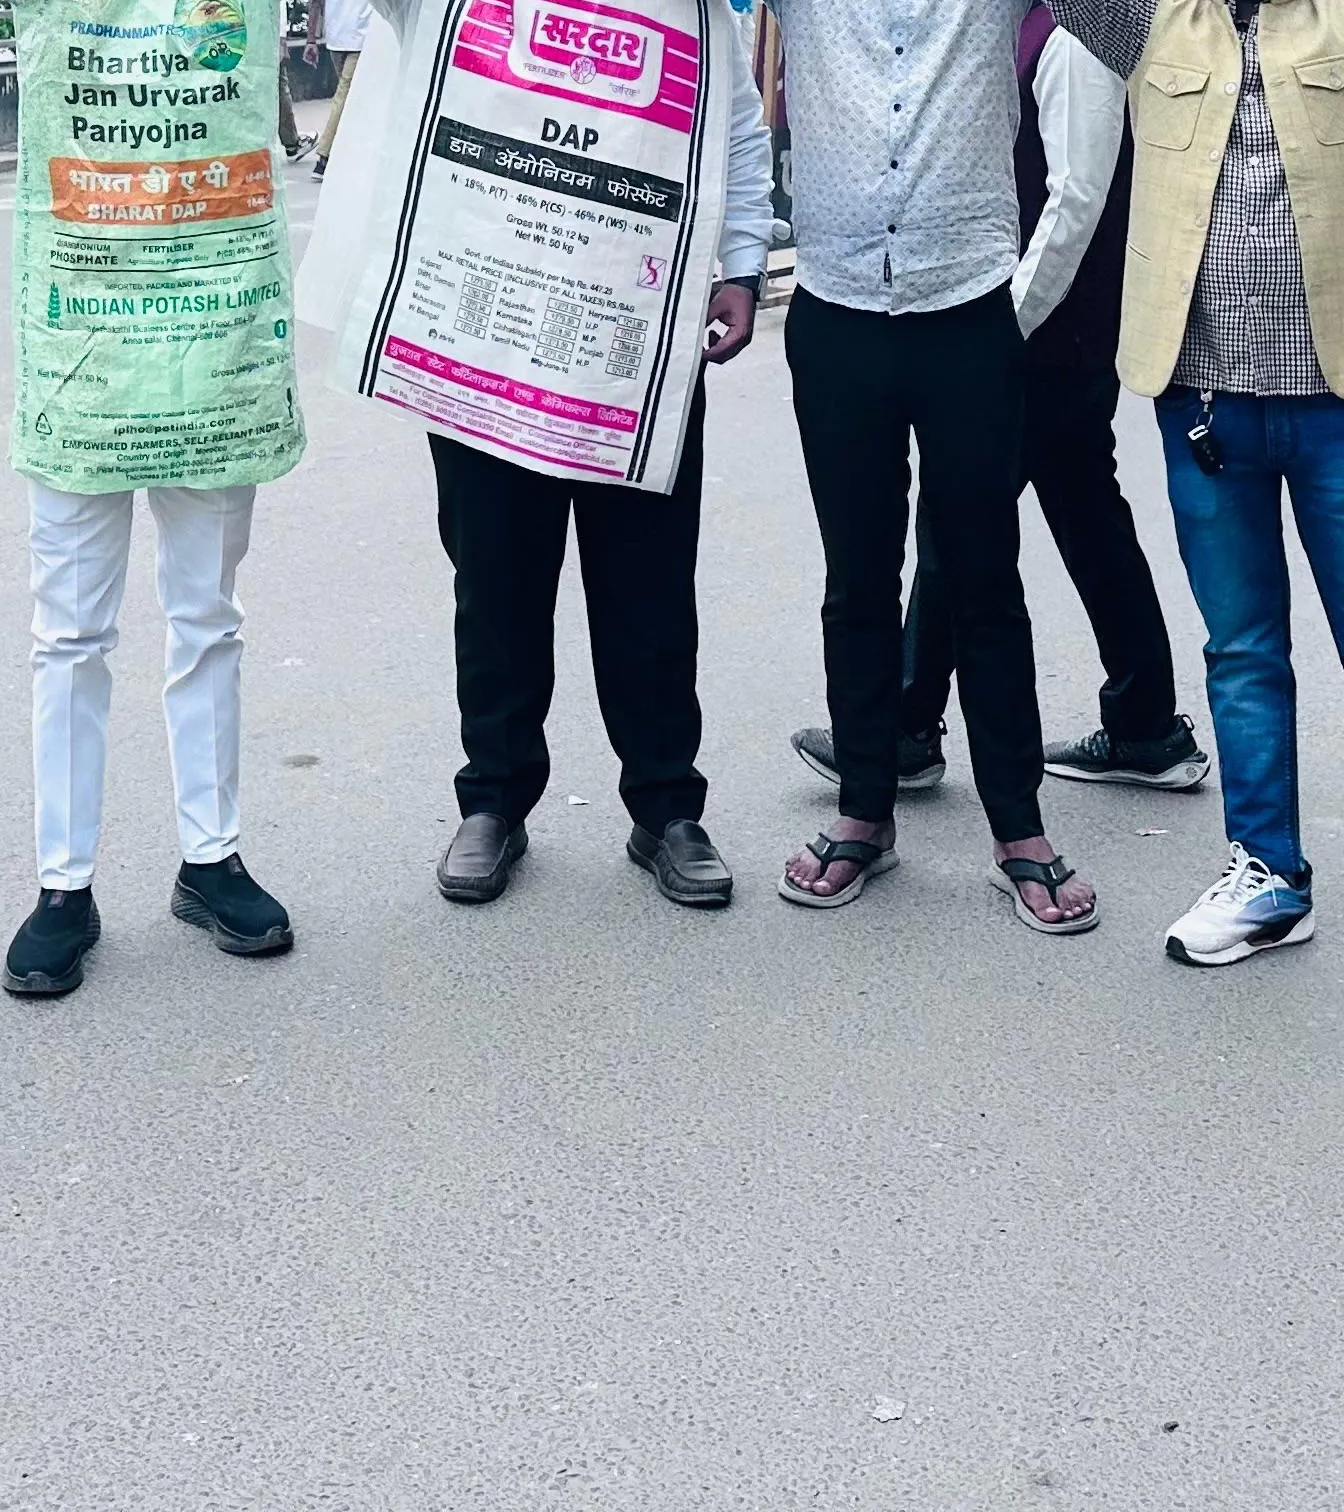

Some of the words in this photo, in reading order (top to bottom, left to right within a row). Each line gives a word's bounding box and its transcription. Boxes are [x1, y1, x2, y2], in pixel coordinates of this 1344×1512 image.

[70, 21, 177, 39] PRADHANMANTR
[539, 12, 642, 62] सरदार
[68, 46, 189, 76] Bhartiya
[64, 83, 117, 107] Jan
[128, 76, 240, 107] Urvarak
[72, 116, 208, 150] Pariyojna
[541, 118, 599, 152] DAP
[69, 169, 133, 194] भारत
[139, 164, 171, 195] डी
[178, 171, 197, 195] ए
[202, 160, 230, 188] पी
[449, 135, 485, 160] डाय
[606, 177, 668, 209] फोस्फेट
[88, 203, 165, 221] BHARAT
[172, 201, 207, 219] DAP
[451, 172, 458, 183] N
[489, 185, 508, 201] P(T)
[516, 193, 538, 208] 46%
[540, 199, 566, 217] P(CS)
[574, 208, 597, 223] 46%
[606, 216, 628, 232] (WS)
[634, 223, 653, 236] 41%
[506, 213, 533, 229] Gross
[578, 232, 590, 245] kg
[515, 229, 531, 241] Net
[549, 238, 561, 249] 50
[562, 242, 575, 255] kg
[50, 250, 118, 265] PHOSPHATE
[66, 296, 135, 316] INDIAN
[142, 292, 219, 316] POTASH
[226, 280, 281, 310] LIMITED
[146, 281, 175, 290] PACKED
[62, 439, 128, 451] EMPOWERED
[131, 438, 181, 450] FARMERS,
[256, 422, 280, 435] INDIA
[116, 452, 151, 461] Country
[153, 452, 162, 460] of
